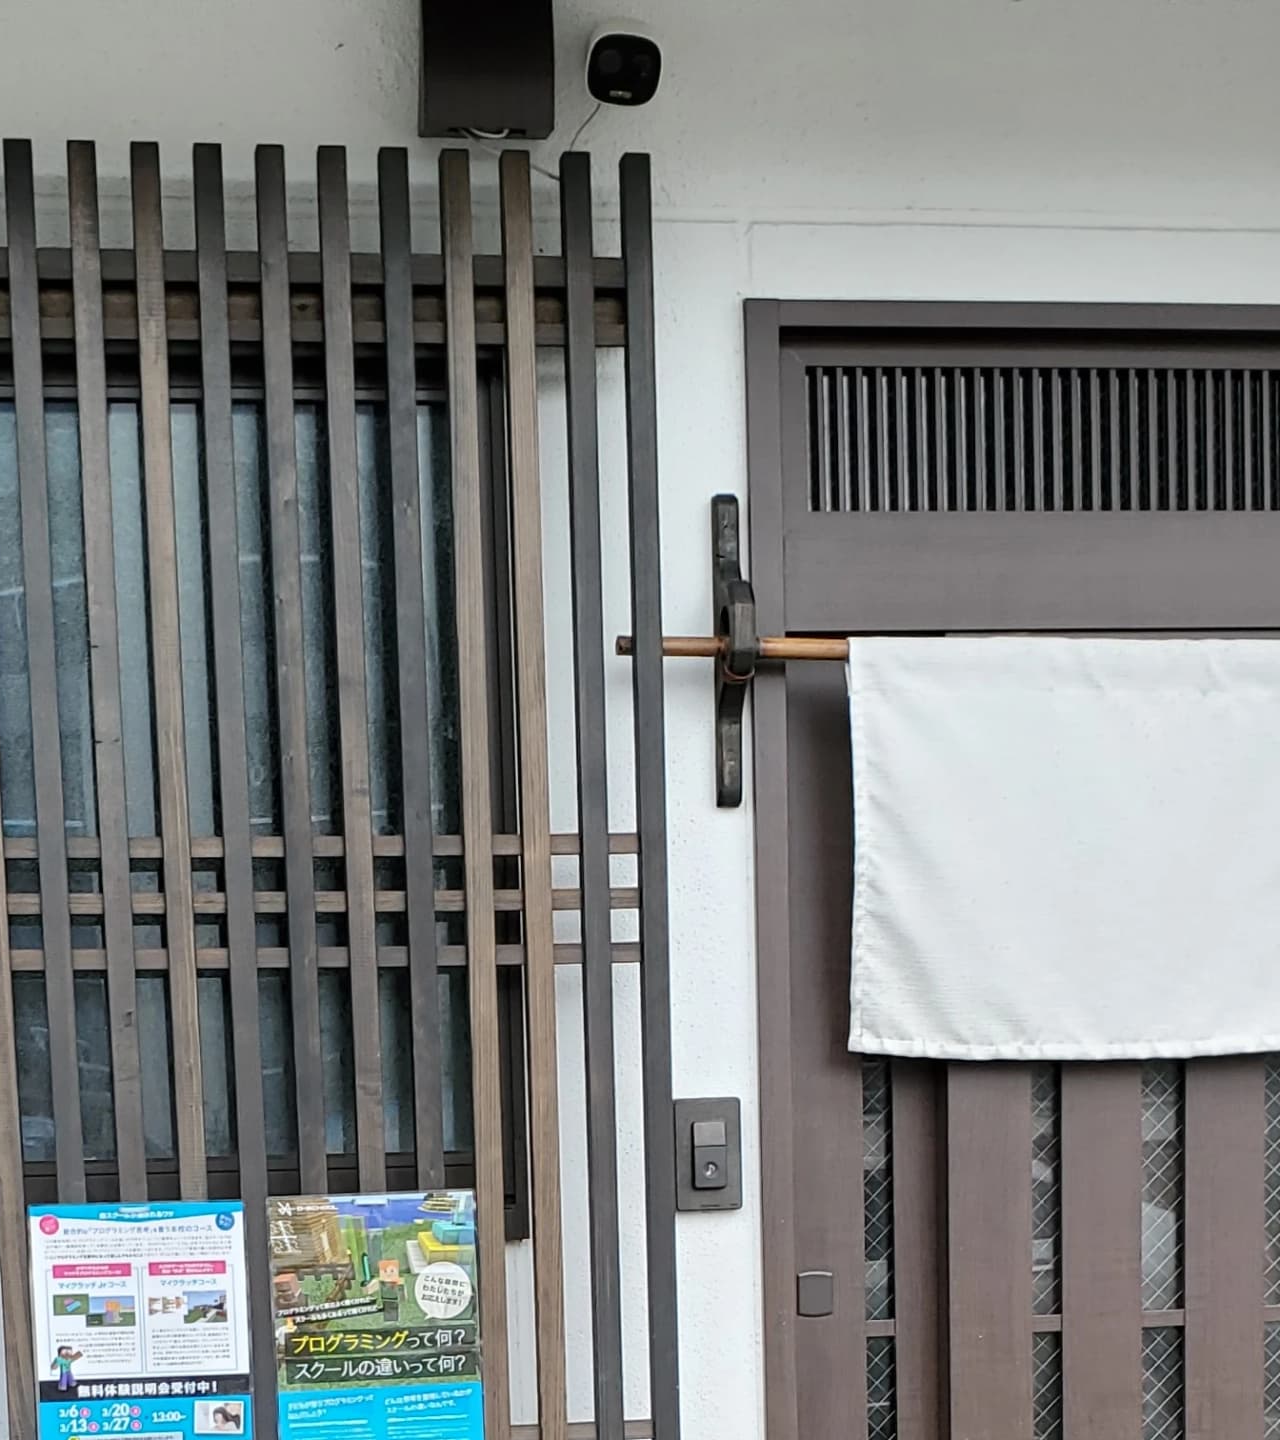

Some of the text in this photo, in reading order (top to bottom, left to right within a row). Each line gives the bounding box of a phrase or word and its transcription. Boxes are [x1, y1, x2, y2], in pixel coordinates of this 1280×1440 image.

[291, 1328, 466, 1354] プログラミングって何?
[294, 1355, 465, 1379] スクールの違いって何?
[77, 1381, 219, 1398] 無料体験説明会受付中!
